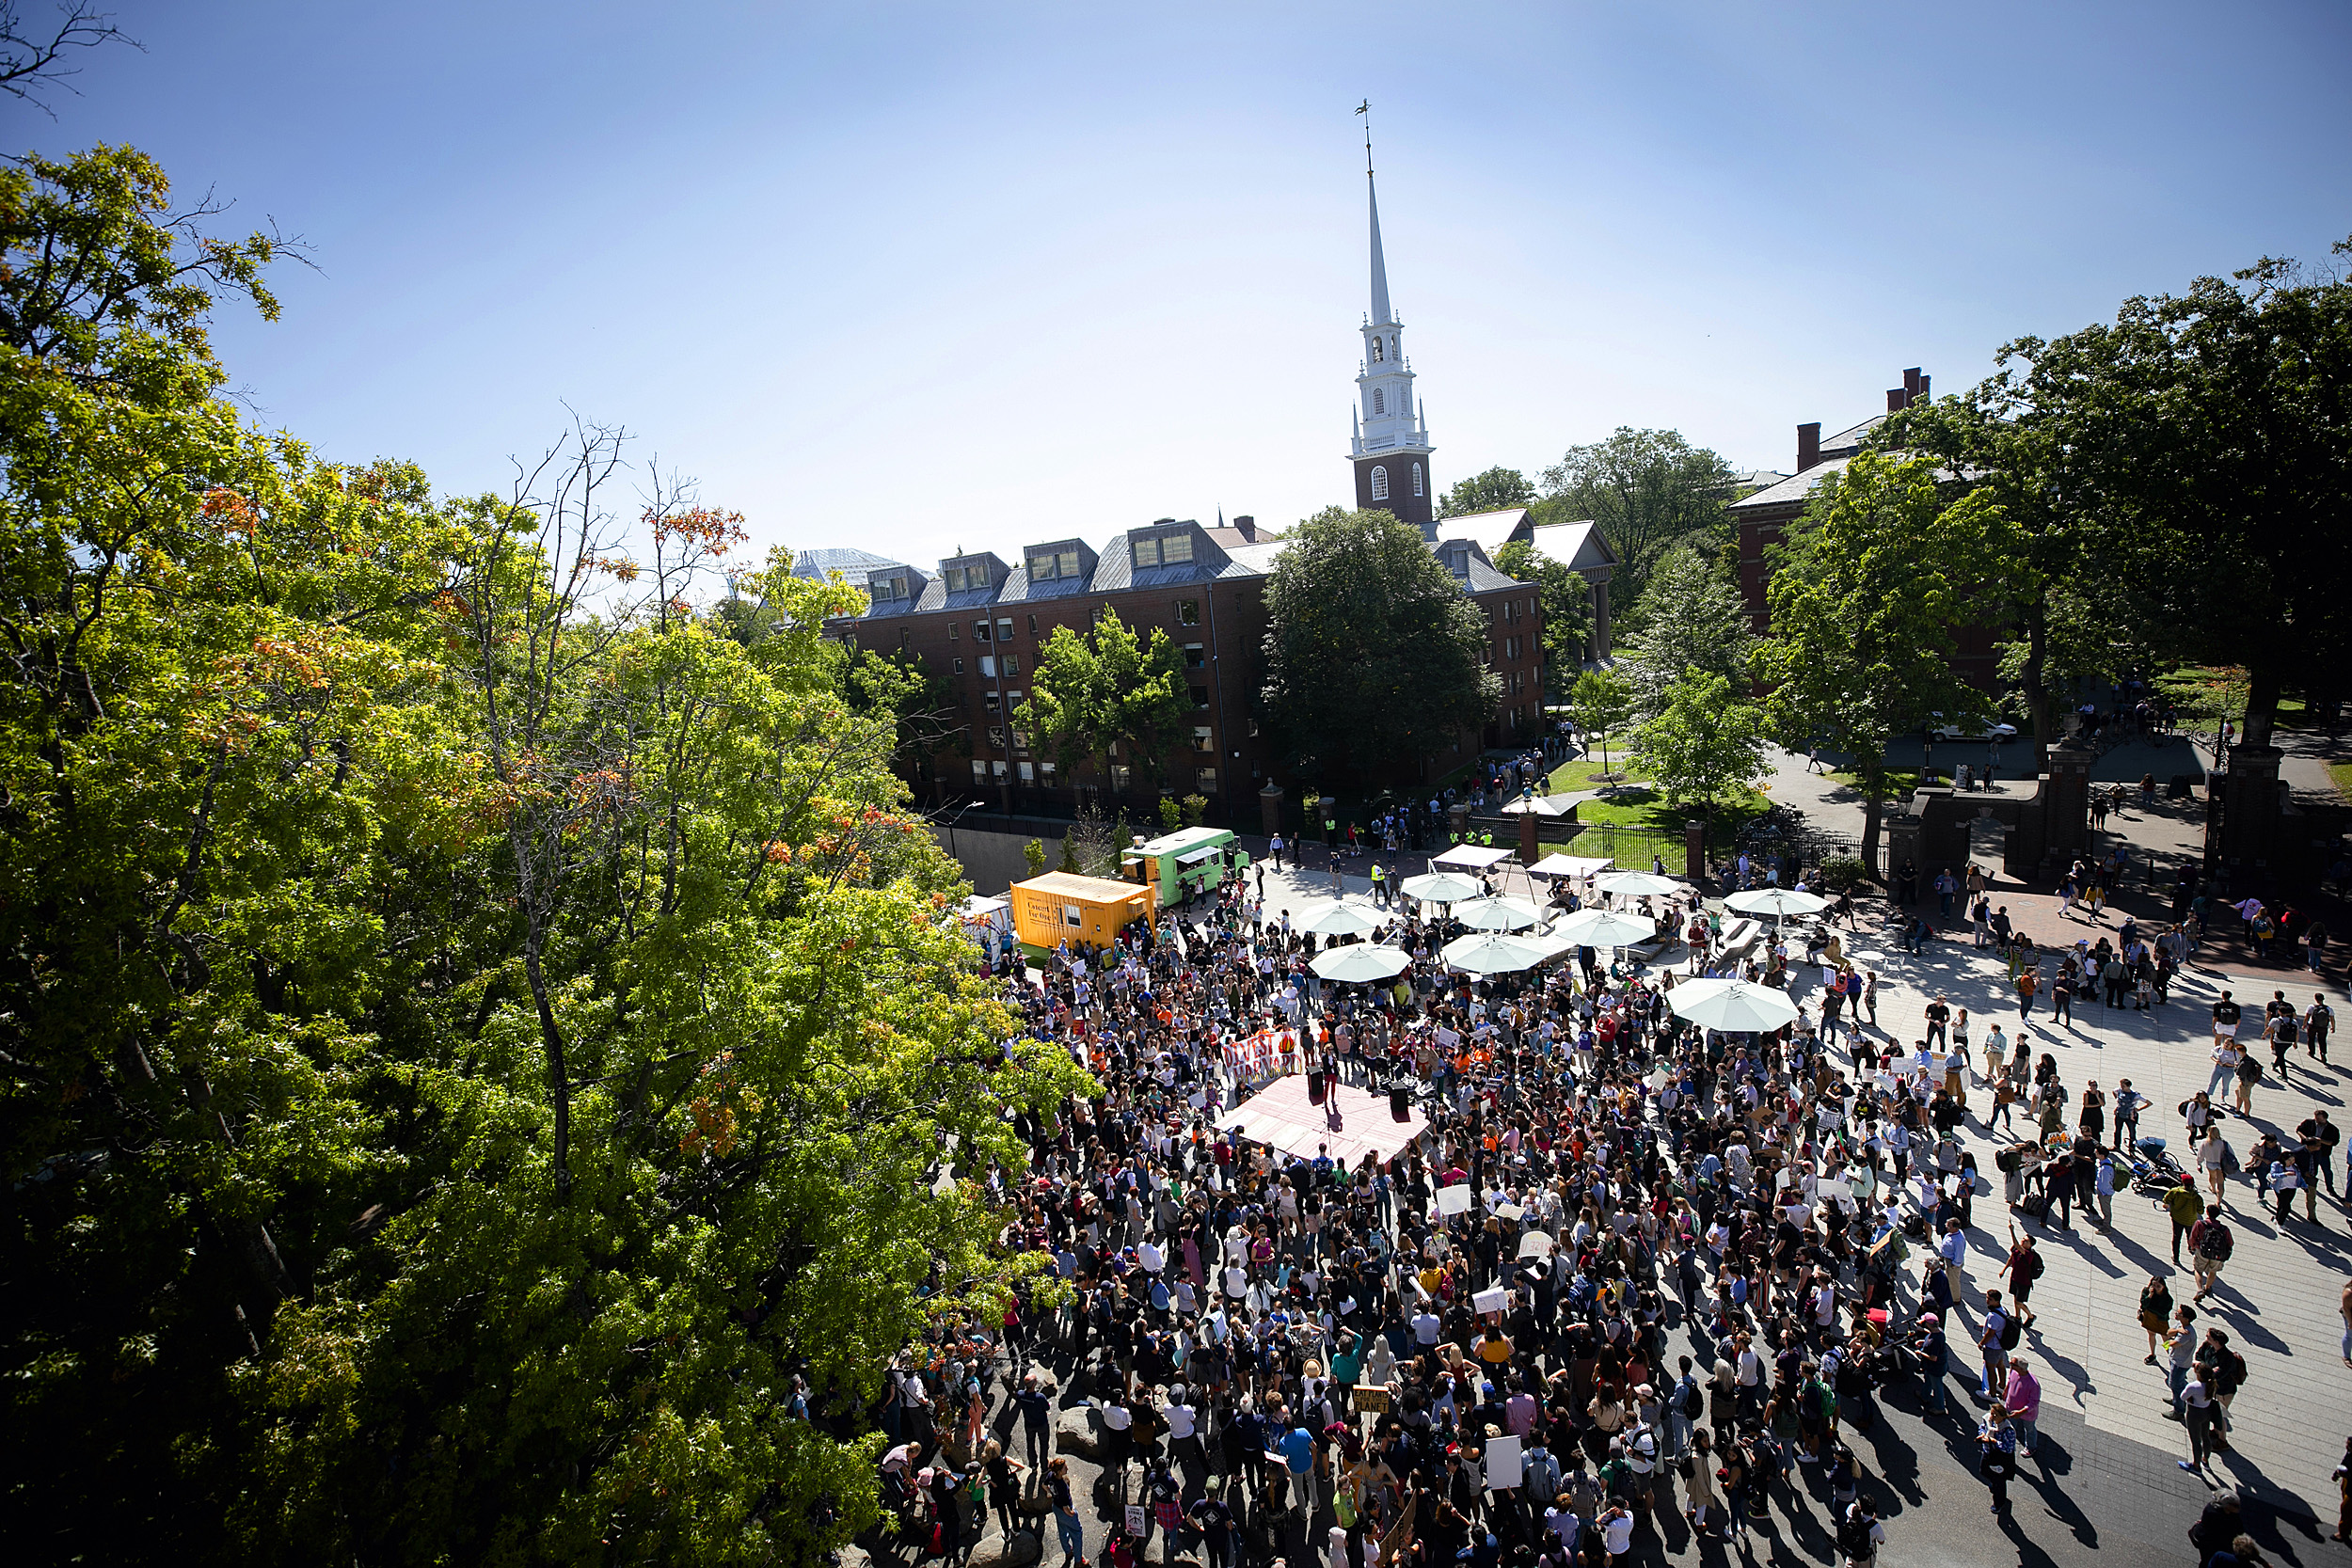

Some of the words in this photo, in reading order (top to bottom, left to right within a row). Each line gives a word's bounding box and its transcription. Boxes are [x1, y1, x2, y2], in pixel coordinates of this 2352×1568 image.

[1027, 901, 1050, 913] Concert
[1028, 910, 1039, 918] For
[1039, 911, 1052, 922] One
[1223, 1034, 1276, 1068] DIVEST
[1233, 1053, 1302, 1084] HARVARD
[1369, 1390, 1389, 1399] PLANTS
[1355, 1401, 1388, 1412] PLANET
